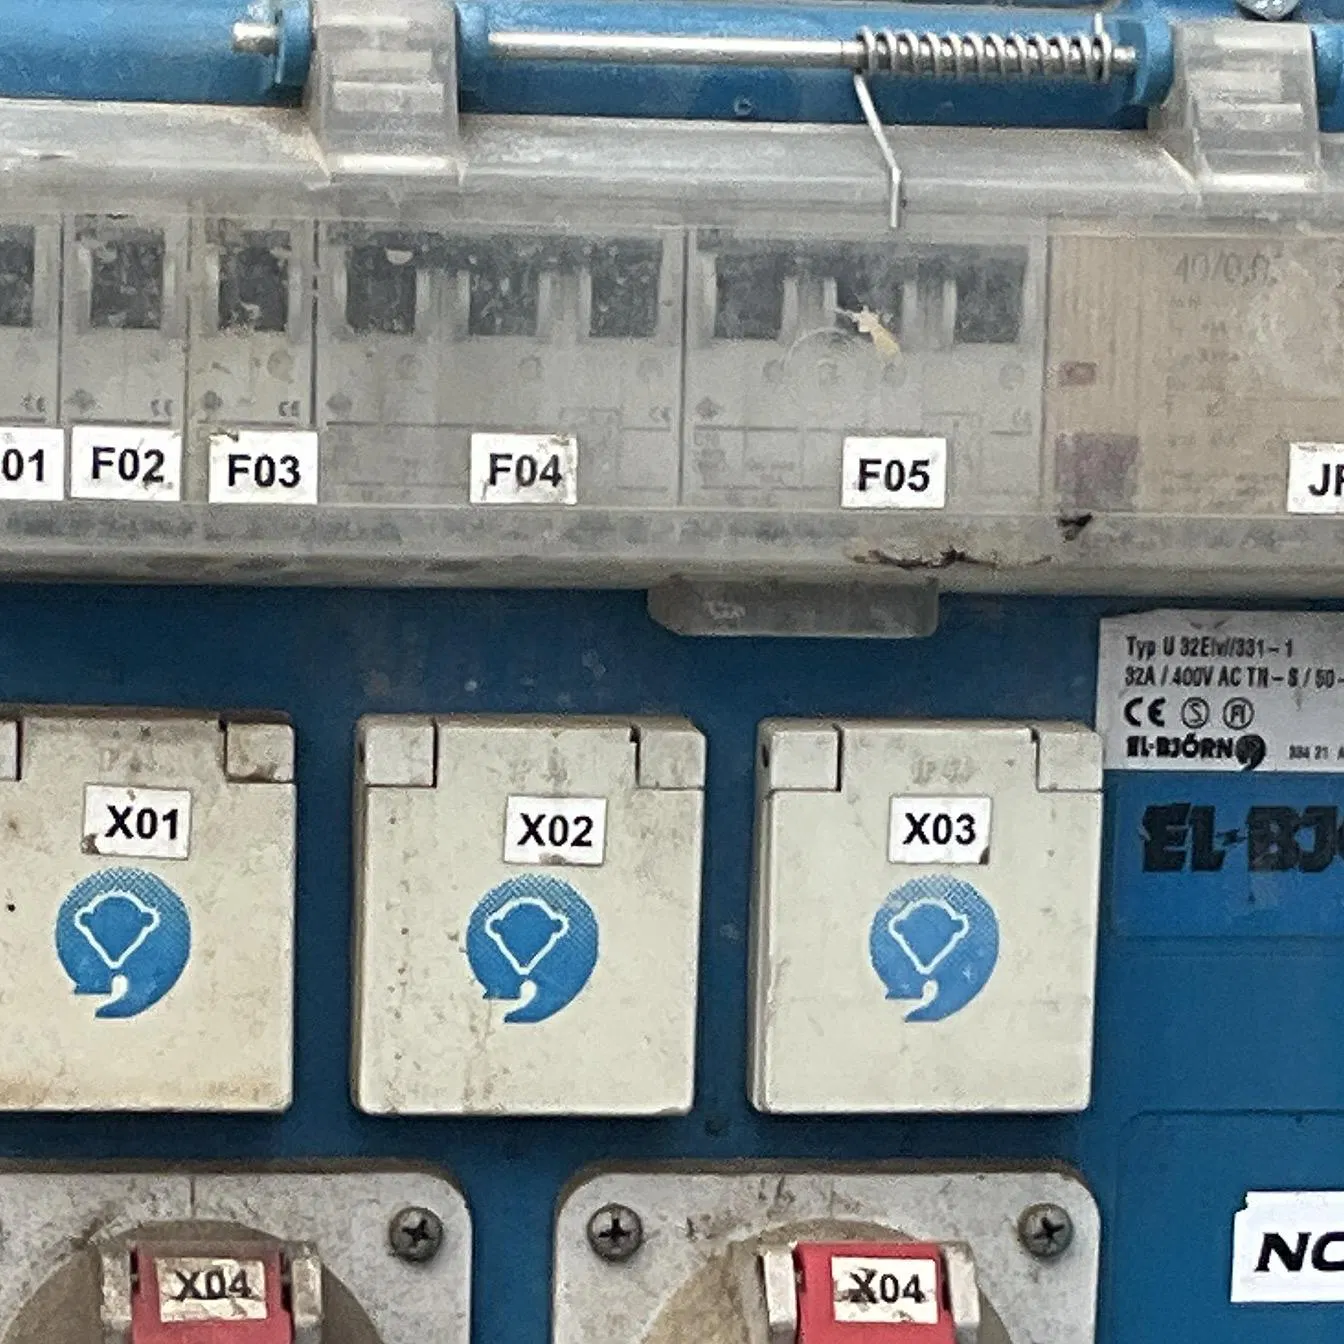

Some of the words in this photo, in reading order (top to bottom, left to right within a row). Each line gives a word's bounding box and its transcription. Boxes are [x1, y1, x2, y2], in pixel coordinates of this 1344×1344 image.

[92, 446, 165, 483] F02
[228, 453, 301, 488] F03
[489, 453, 563, 488] F04
[857, 458, 930, 492] F05
[1126, 636, 1156, 660] Typ
[1163, 636, 1175, 656] U
[1125, 665, 1156, 687] 32A
[1172, 665, 1214, 687] 400V
[1218, 666, 1242, 687] AC
[104, 805, 179, 841] X01
[517, 812, 593, 848] X02
[902, 812, 976, 846] X03
[172, 1266, 254, 1302] X04
[848, 1268, 927, 1305] X04
